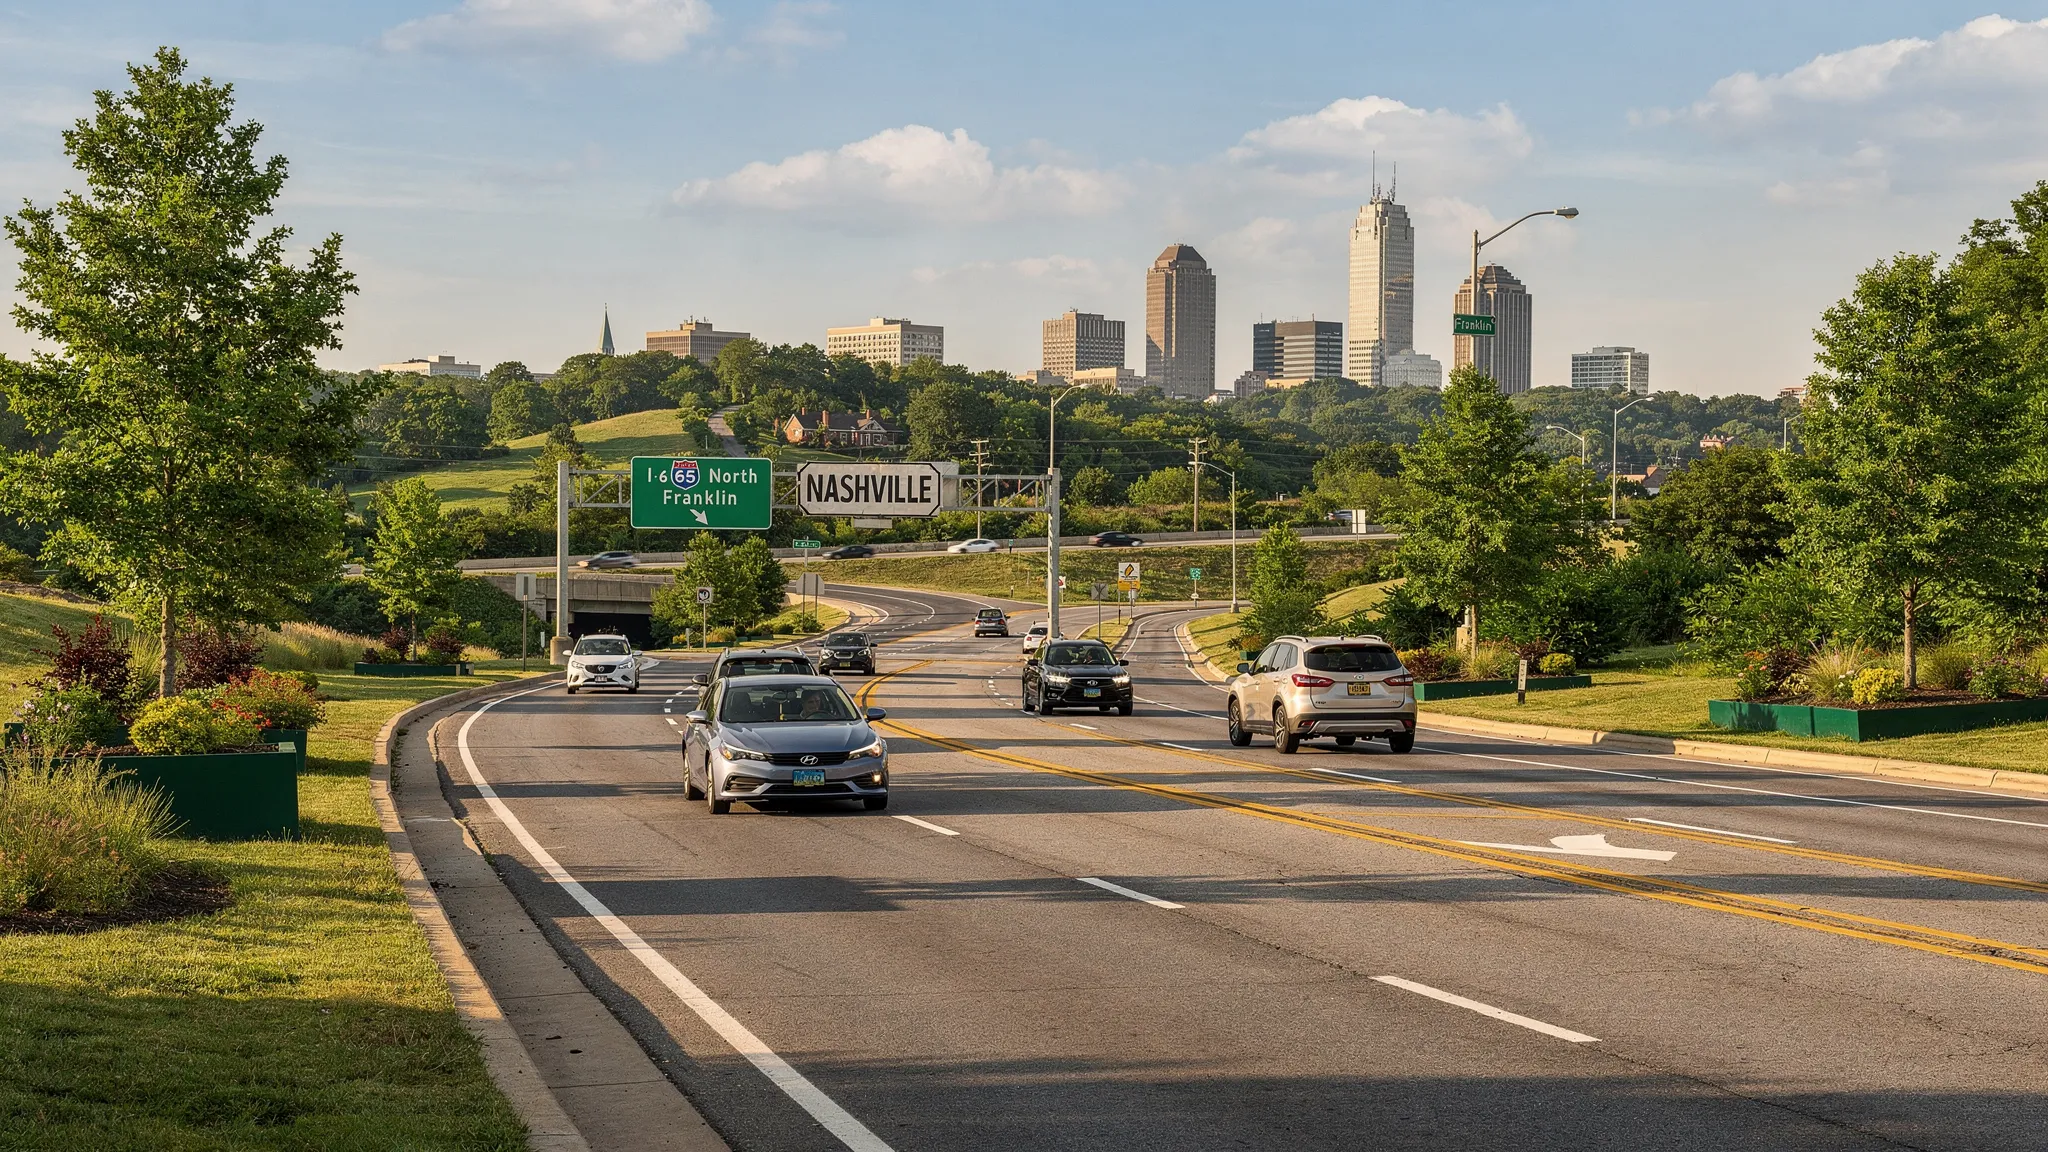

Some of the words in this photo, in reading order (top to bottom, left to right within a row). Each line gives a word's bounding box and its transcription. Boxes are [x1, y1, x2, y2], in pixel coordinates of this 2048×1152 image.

[1455, 317, 1492, 331] Franklin
[674, 469, 696, 483] 65
[709, 467, 758, 484] North
[806, 473, 932, 504] NASHVILLE
[663, 489, 738, 506] Franklin
